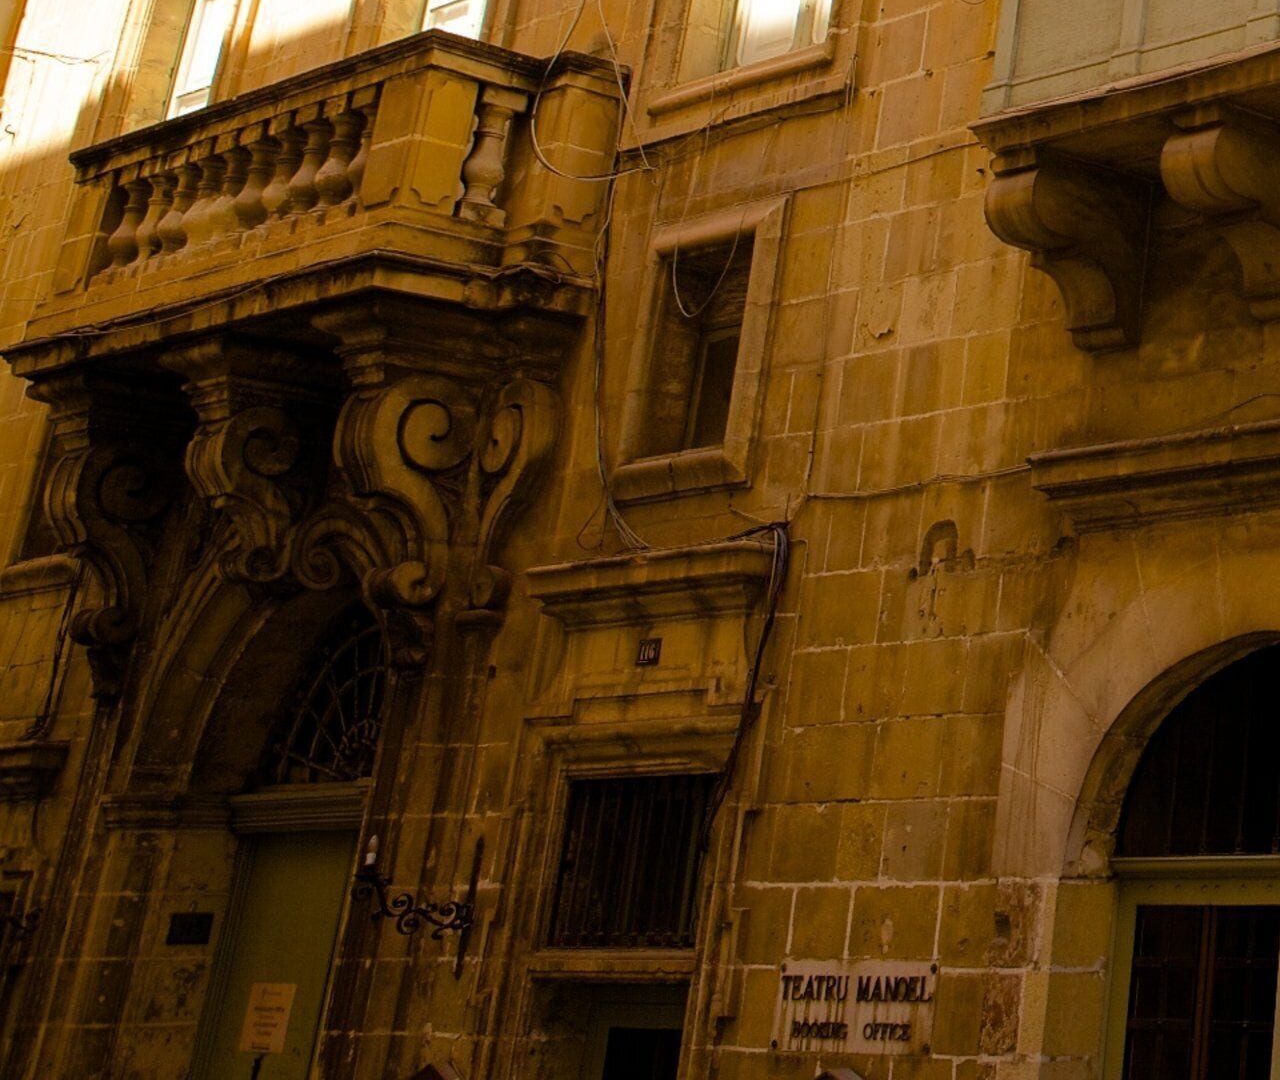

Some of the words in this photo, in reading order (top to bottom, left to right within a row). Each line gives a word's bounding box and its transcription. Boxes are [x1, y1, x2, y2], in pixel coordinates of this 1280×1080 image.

[781, 974, 849, 1001] TEATRU
[856, 975, 933, 1003] MANOEL
[793, 1021, 848, 1040] BOOKING
[863, 1022, 912, 1041] OFFICE
